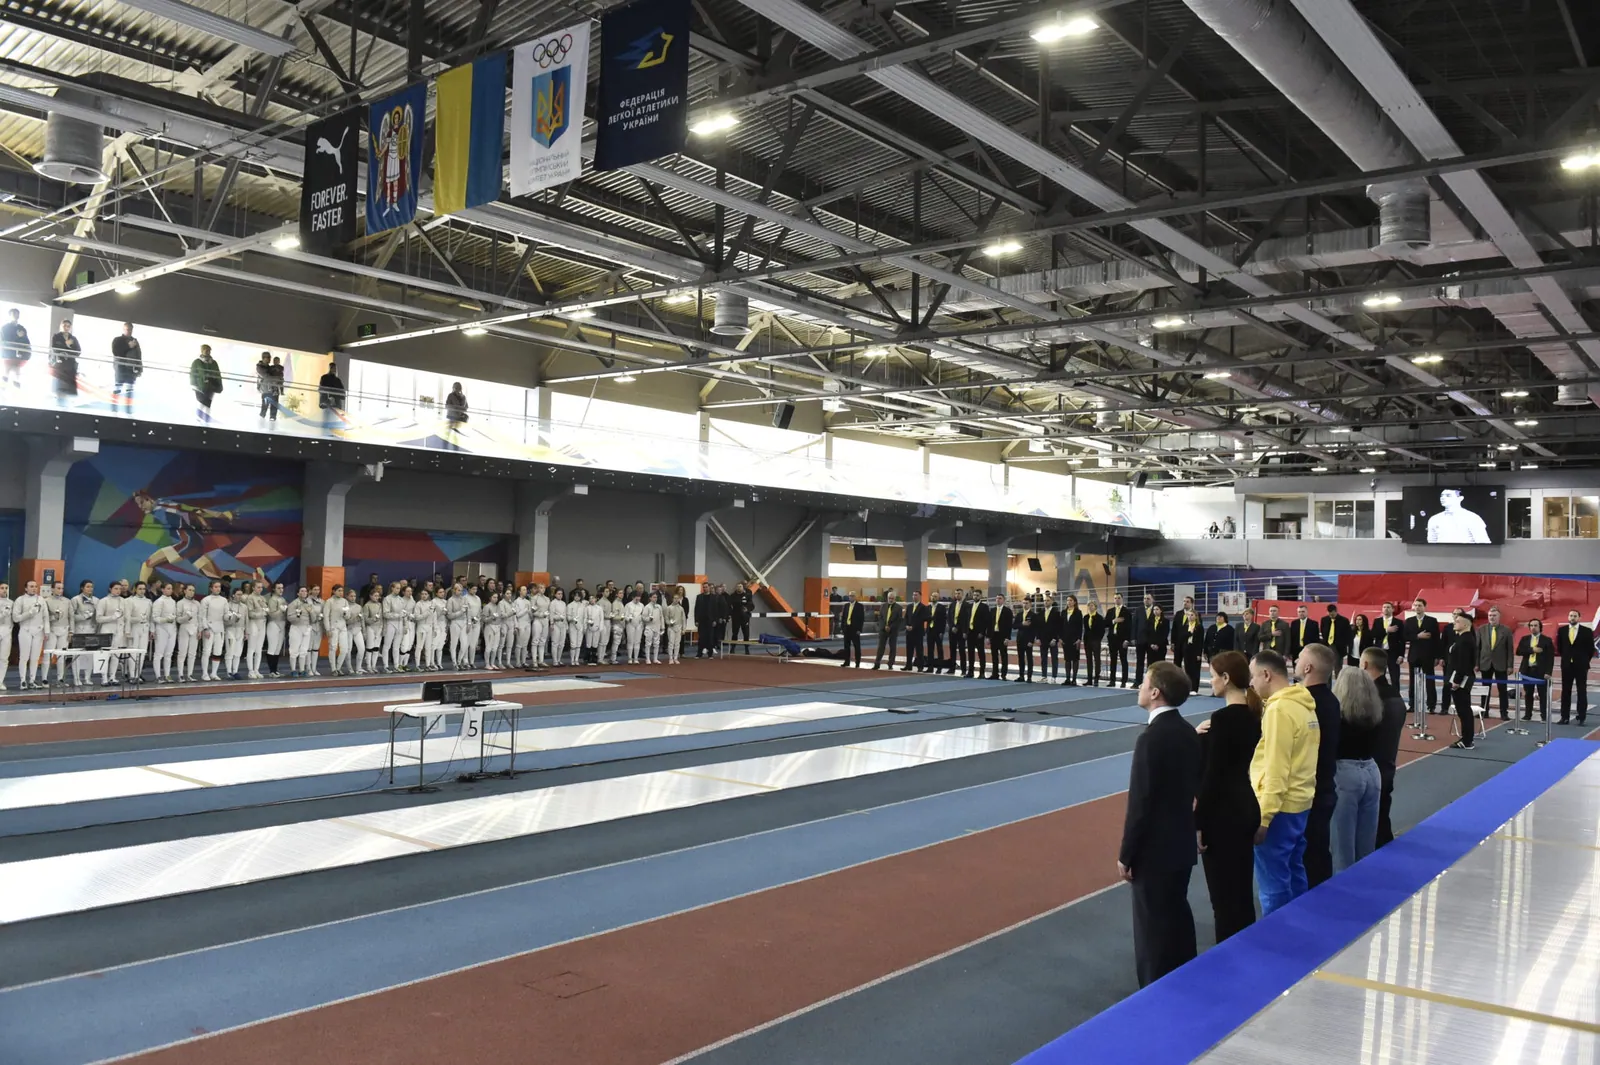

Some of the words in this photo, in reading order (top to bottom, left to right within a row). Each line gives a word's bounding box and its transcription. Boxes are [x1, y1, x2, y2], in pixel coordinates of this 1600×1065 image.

[620, 88, 665, 108] ФЕДЕРАЦІЯ
[608, 108, 634, 125] ЛЕГКОЇ
[636, 96, 679, 116] АТЛЕТИКИ
[623, 113, 659, 131] УКРАЇНИ
[311, 183, 348, 211] FOREVER.
[312, 207, 343, 232] FASTER.
[98, 659, 105, 671] 7
[467, 720, 478, 737] 5
